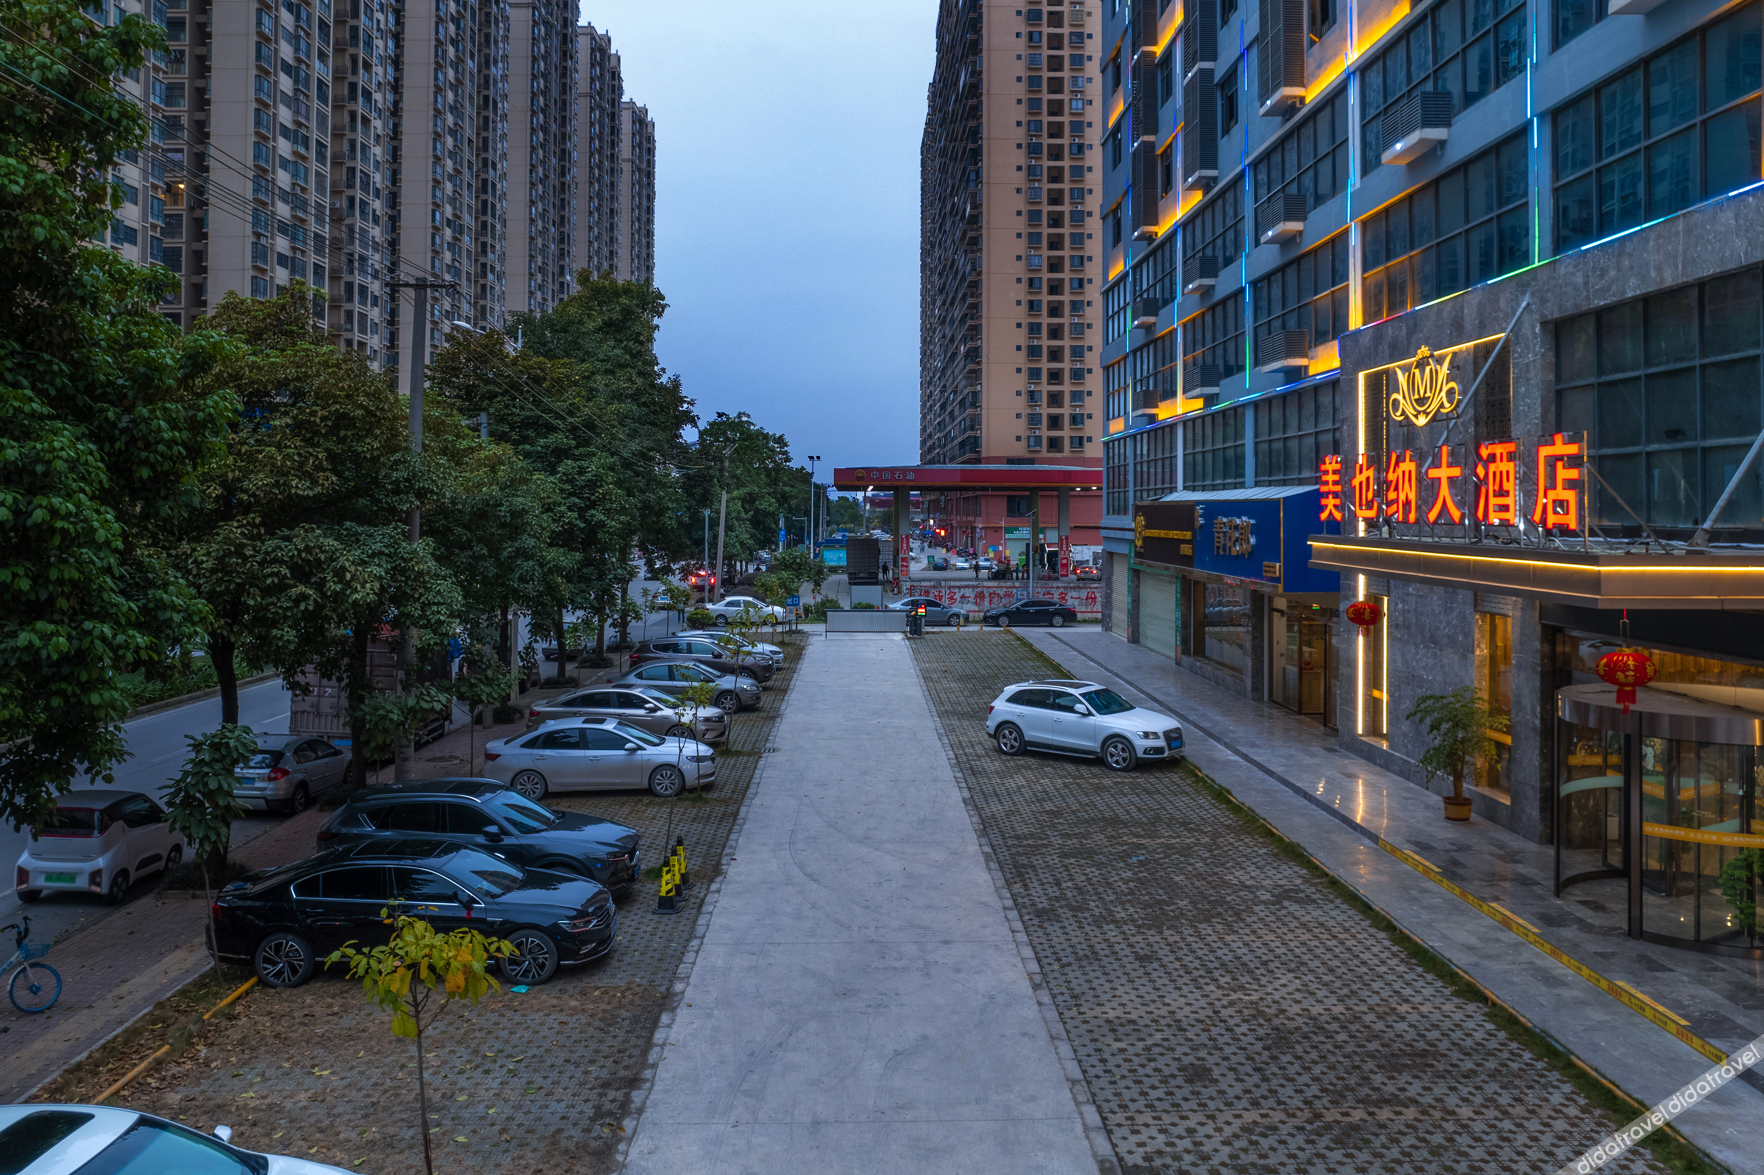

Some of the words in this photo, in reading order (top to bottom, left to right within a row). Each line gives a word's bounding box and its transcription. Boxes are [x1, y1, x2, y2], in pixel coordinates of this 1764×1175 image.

[870, 470, 915, 480] 中国石油
[1319, 433, 1580, 531] 美也纳大酒店
[1213, 516, 1256, 558] 青花郎
